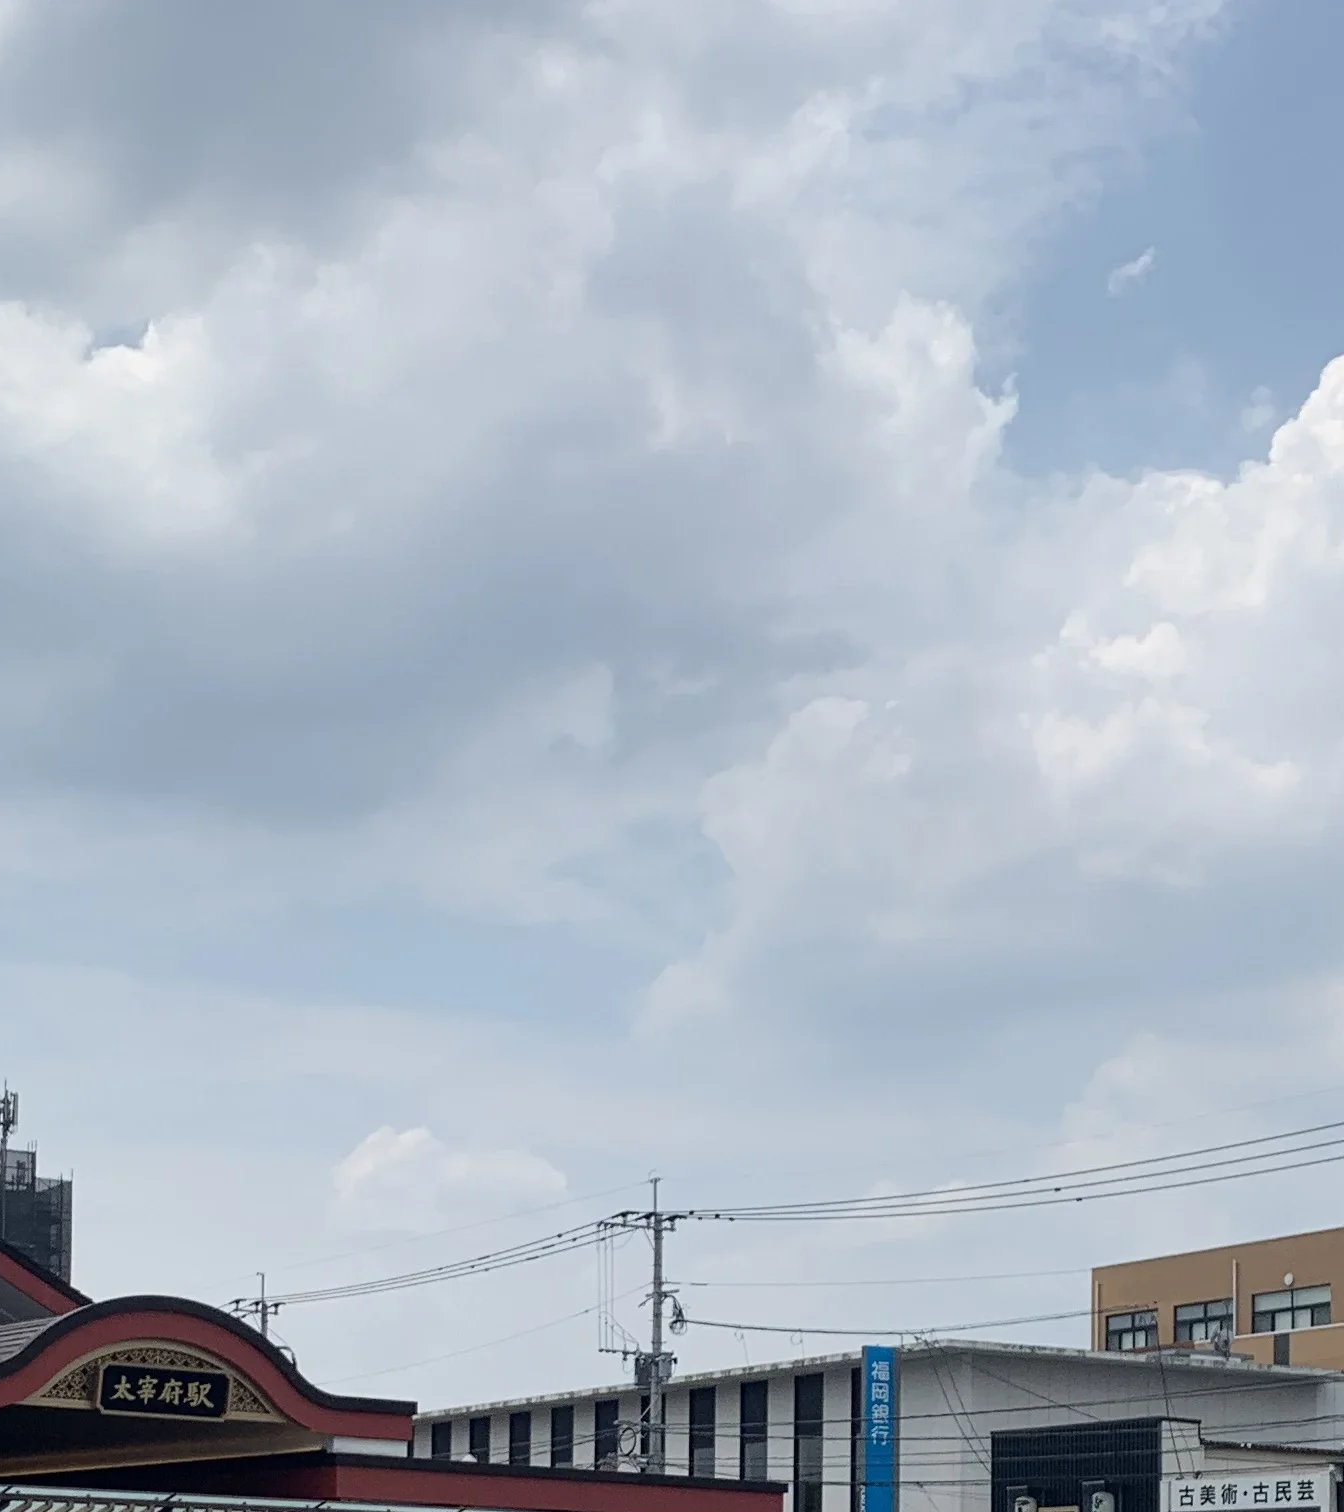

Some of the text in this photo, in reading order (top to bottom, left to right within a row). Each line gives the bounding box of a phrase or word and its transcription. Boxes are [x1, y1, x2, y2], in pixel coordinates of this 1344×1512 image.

[110, 1375, 214, 1408] 太宰府駅
[871, 1361, 890, 1446] 福岡銀行
[1179, 1479, 1315, 1507] 古美術・古民芸
